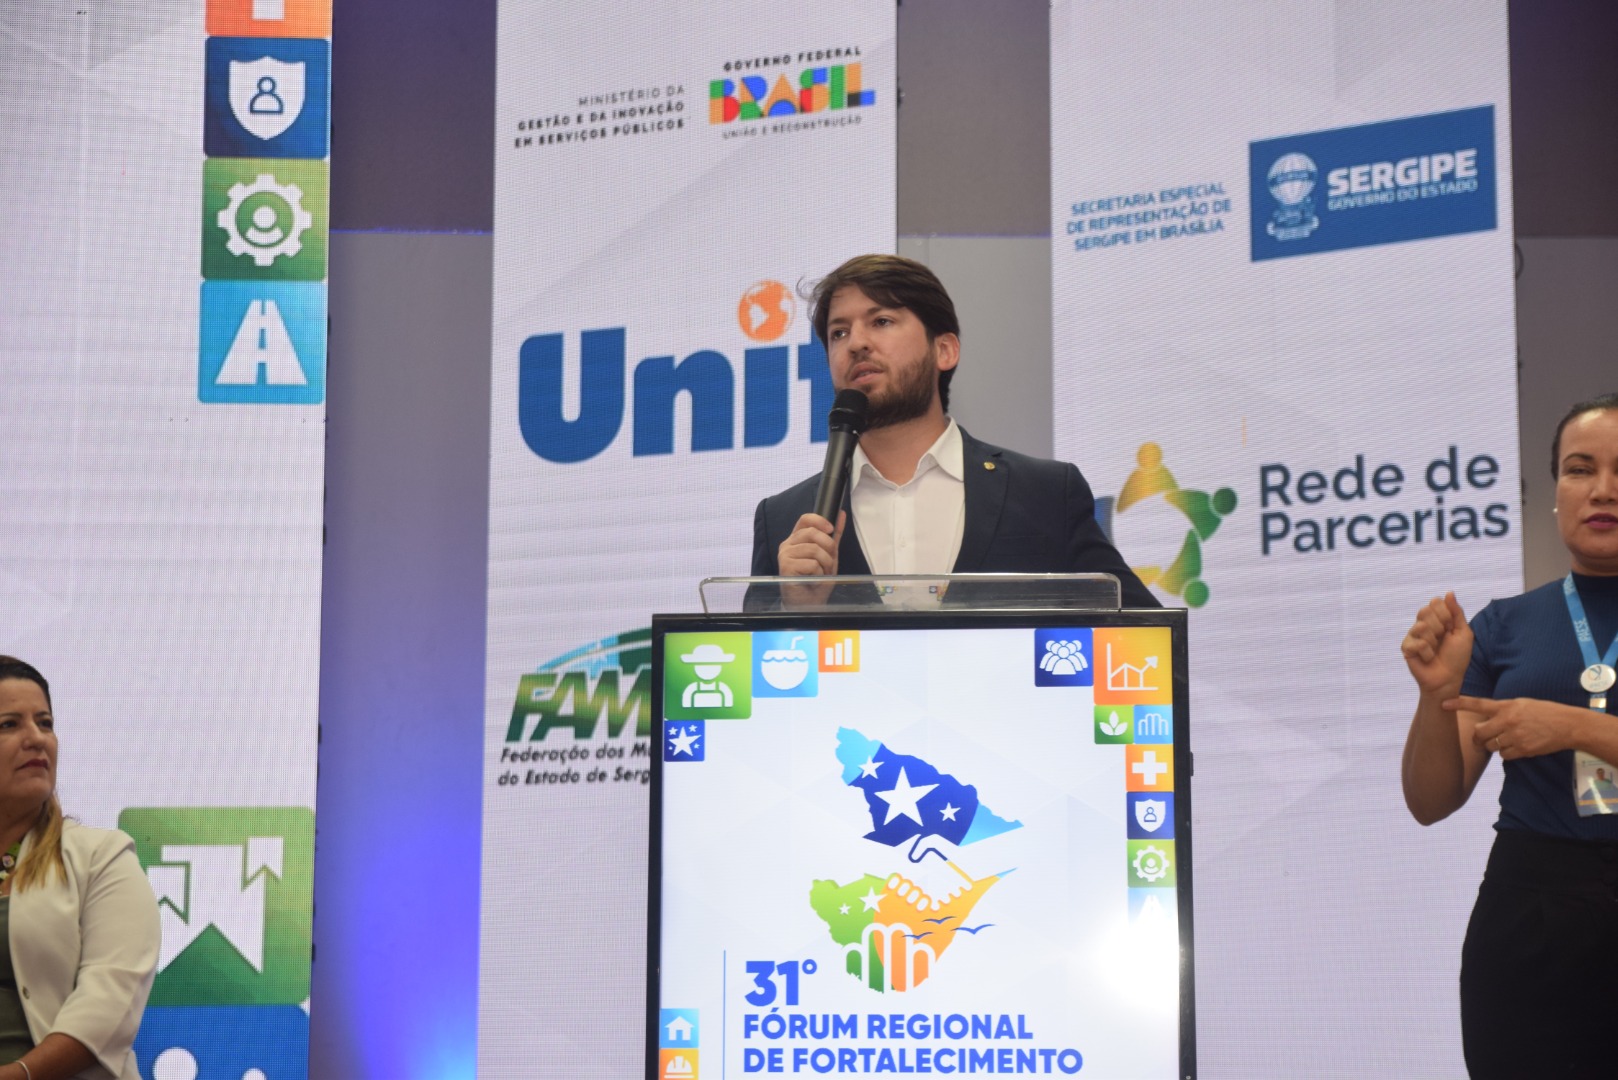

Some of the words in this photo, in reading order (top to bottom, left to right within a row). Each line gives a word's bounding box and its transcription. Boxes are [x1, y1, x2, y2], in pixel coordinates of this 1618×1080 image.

[724, 54, 791, 71] GOVERNO
[798, 46, 861, 62] FEDERAL
[579, 87, 660, 105] MINISTÉRIO
[666, 85, 684, 97] DA
[709, 61, 876, 125] BRASIL
[518, 114, 570, 131] GESTÃO
[577, 113, 583, 124] E
[590, 111, 606, 122] DA
[612, 99, 684, 119] INOVAÇÃO
[723, 126, 757, 139] UNIÃO
[762, 126, 767, 134] E
[772, 115, 861, 134] RECONSTRUÇÃO
[515, 137, 533, 148] EM
[539, 128, 606, 145] SERVIÇOS
[613, 118, 684, 135] PÚBLICOS
[1327, 147, 1478, 197] SERGIPE
[1072, 192, 1155, 216] SECRETARIA
[1160, 182, 1226, 203] ESPECIAL
[1328, 190, 1394, 211] GOVERNO
[1397, 188, 1419, 202] DO
[1421, 178, 1478, 199] ESTADO
[1067, 220, 1084, 234] DE
[1089, 201, 1208, 231] REPRESENTAÇÃO
[1213, 199, 1231, 213] DE
[1075, 231, 1130, 251] SERGIPE
[1135, 228, 1156, 243] EM
[1161, 218, 1224, 240] BRASÍLIA
[1259, 452, 1404, 508] Rede
[1425, 445, 1500, 493] de
[1261, 495, 1509, 555] Parcerias
[501, 745, 589, 765] Federação
[596, 742, 625, 759] dos
[498, 770, 519, 786] do
[525, 767, 580, 785] Estado
[586, 766, 607, 782] de
[743, 1007, 858, 1039] FÓRUM
[866, 1013, 1033, 1039] REGIONAL
[743, 1047, 783, 1073] DE
[793, 1047, 1083, 1074] FORTALECIMENTO
